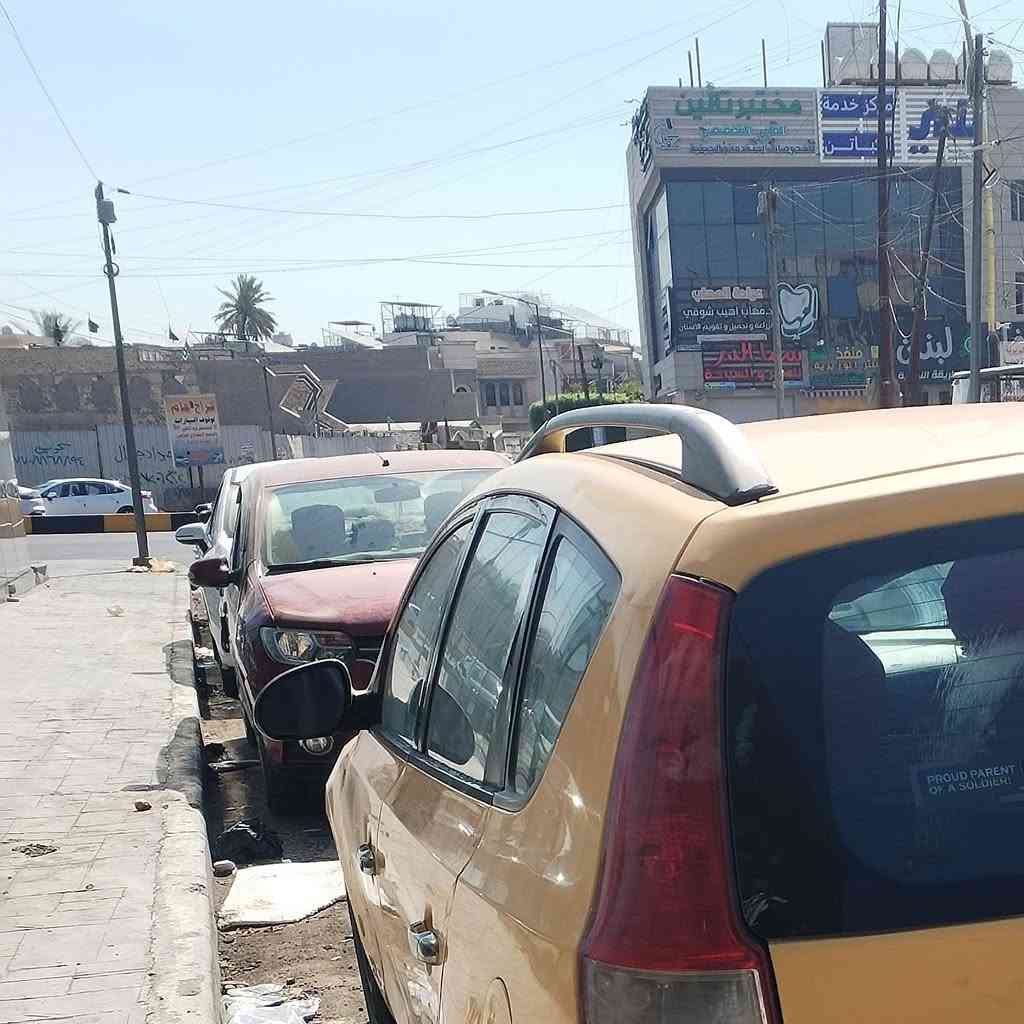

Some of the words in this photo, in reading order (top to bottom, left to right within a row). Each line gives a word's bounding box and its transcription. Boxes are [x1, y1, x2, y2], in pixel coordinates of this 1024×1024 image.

[822, 95, 859, 112] خدمة
[862, 96, 894, 117] مكز
[895, 325, 952, 365] لبنن
[927, 771, 968, 786] PROUD
[969, 764, 1017, 779] PARENT
[928, 784, 944, 796] OF
[947, 784, 957, 794] A
